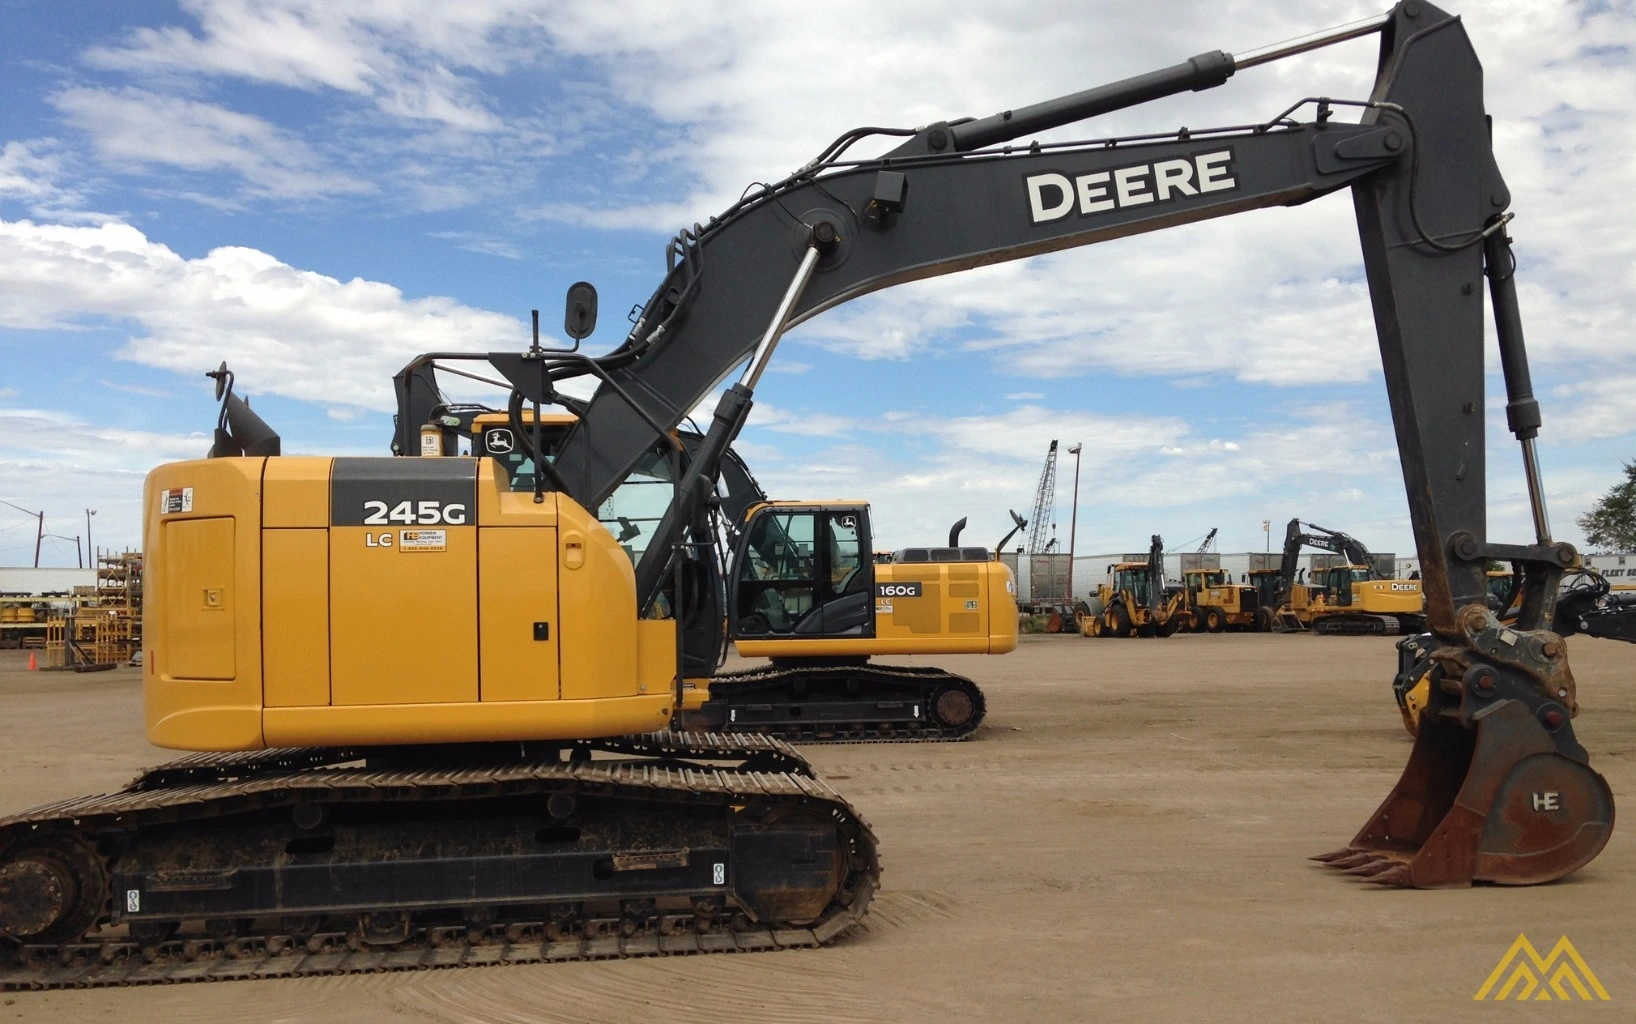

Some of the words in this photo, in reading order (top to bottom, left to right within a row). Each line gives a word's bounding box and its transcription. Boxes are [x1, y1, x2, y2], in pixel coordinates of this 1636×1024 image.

[1026, 150, 1236, 223] DEERE
[363, 500, 466, 525] 245G
[366, 533, 393, 547] LC
[1309, 538, 1329, 547] DEERE
[1601, 569, 1625, 578] FLEET
[880, 586, 916, 596] 160G
[1391, 583, 1418, 591] DEERE
[1533, 792, 1560, 811] HE
